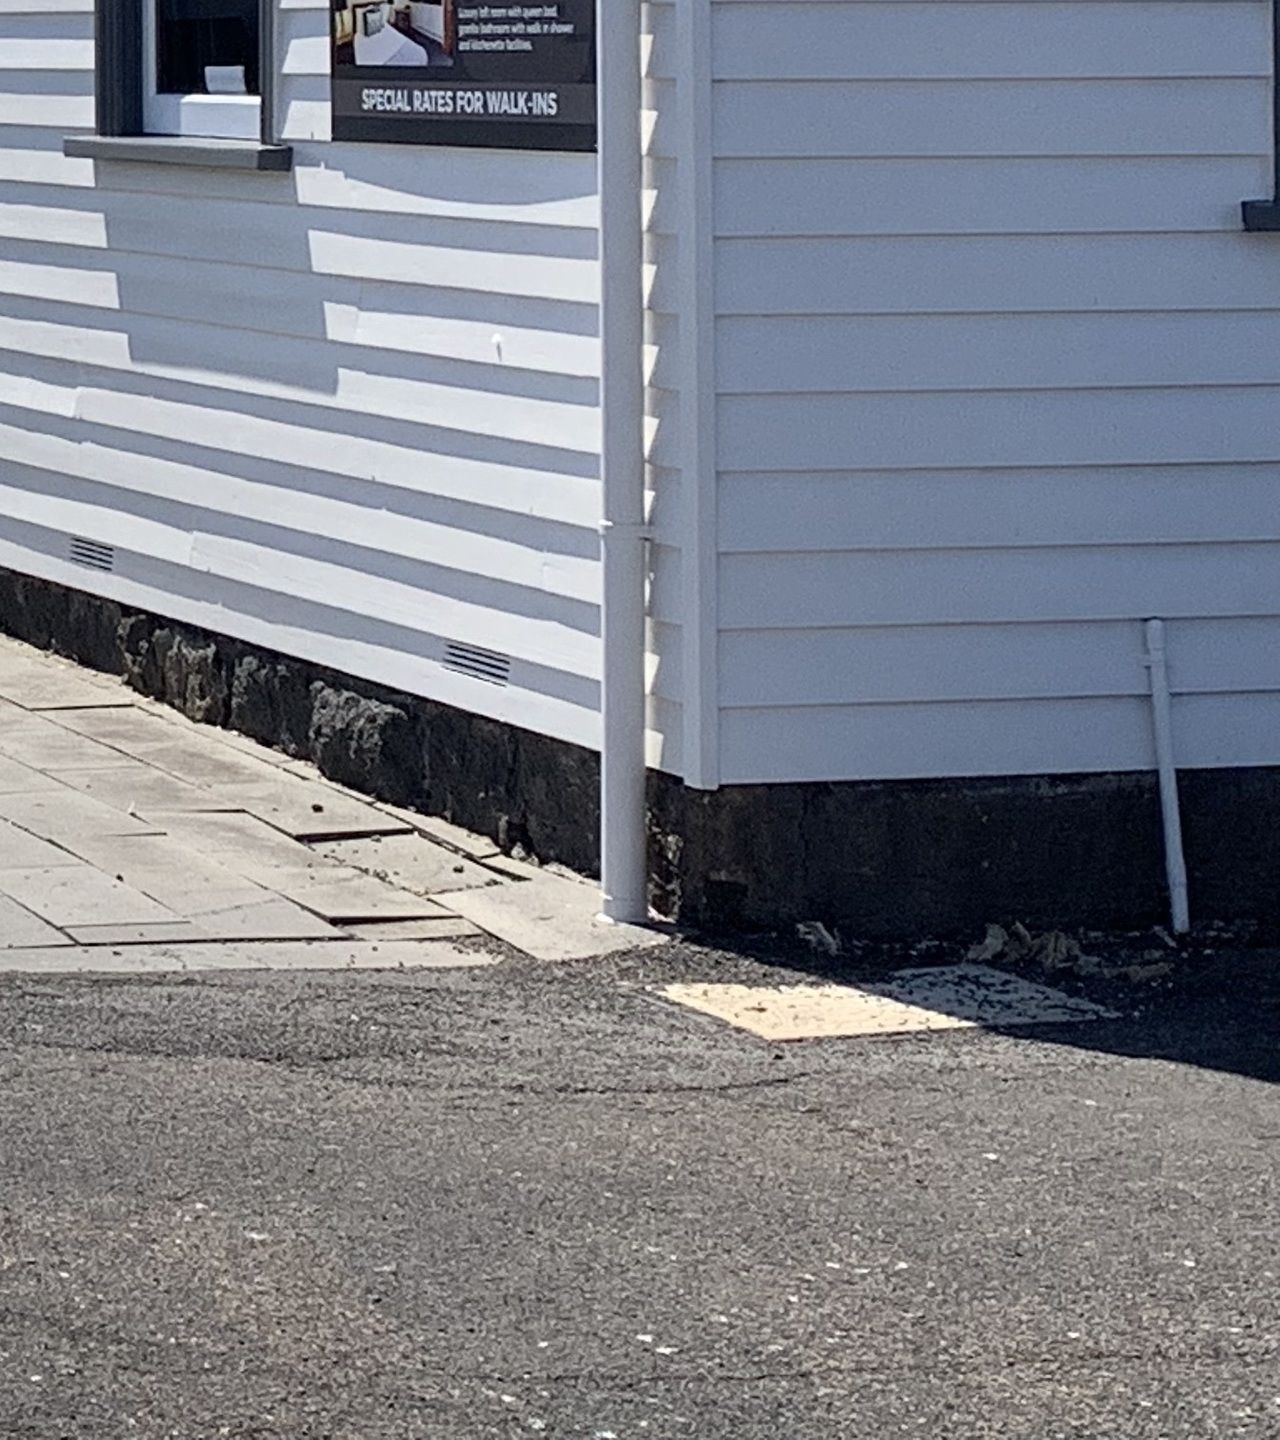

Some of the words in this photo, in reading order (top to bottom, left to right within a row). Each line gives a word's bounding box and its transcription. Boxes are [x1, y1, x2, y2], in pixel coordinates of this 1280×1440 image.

[362, 89, 410, 111] SPECIAL
[413, 90, 453, 112] RATES
[457, 91, 483, 114] FOR
[487, 91, 558, 116] WALK-INS
